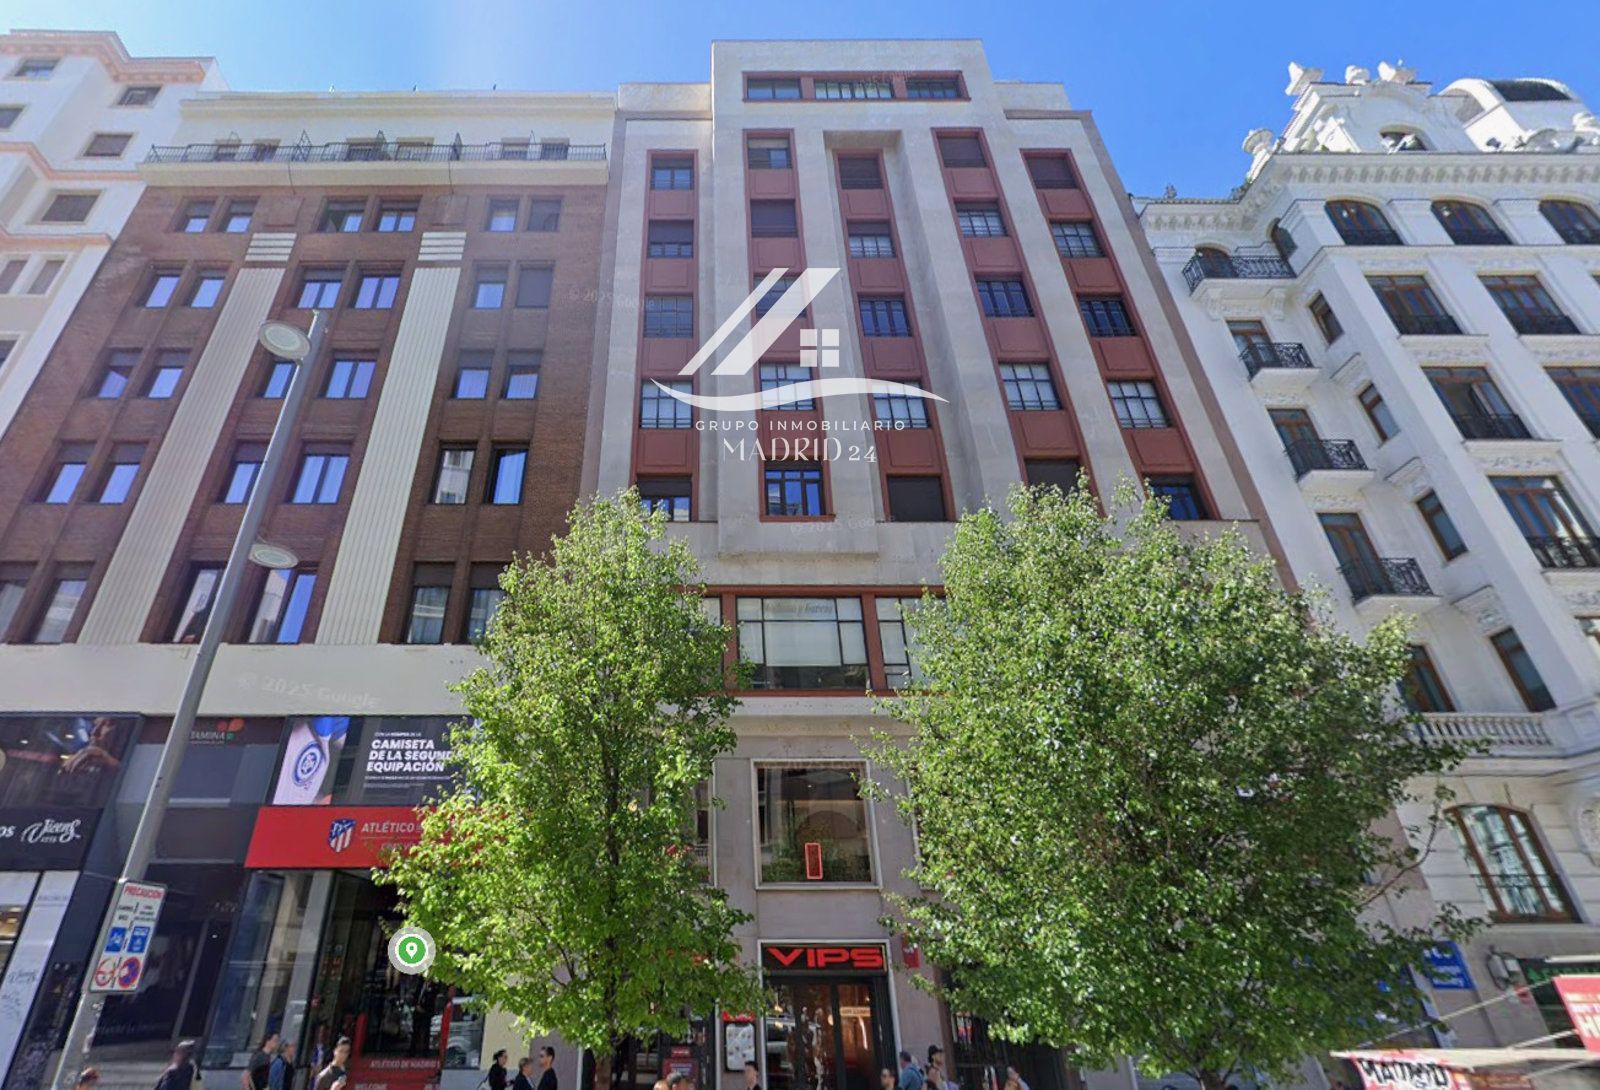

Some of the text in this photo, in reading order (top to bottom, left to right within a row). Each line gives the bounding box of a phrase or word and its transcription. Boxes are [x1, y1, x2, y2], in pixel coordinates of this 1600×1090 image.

[371, 739, 435, 750] CAMISETA
[368, 750, 463, 762] DE LA SEGUND
[366, 760, 445, 772] EQUIPACIÓN
[360, 821, 415, 833] ATLÉTICO
[767, 947, 883, 968] VIPS
